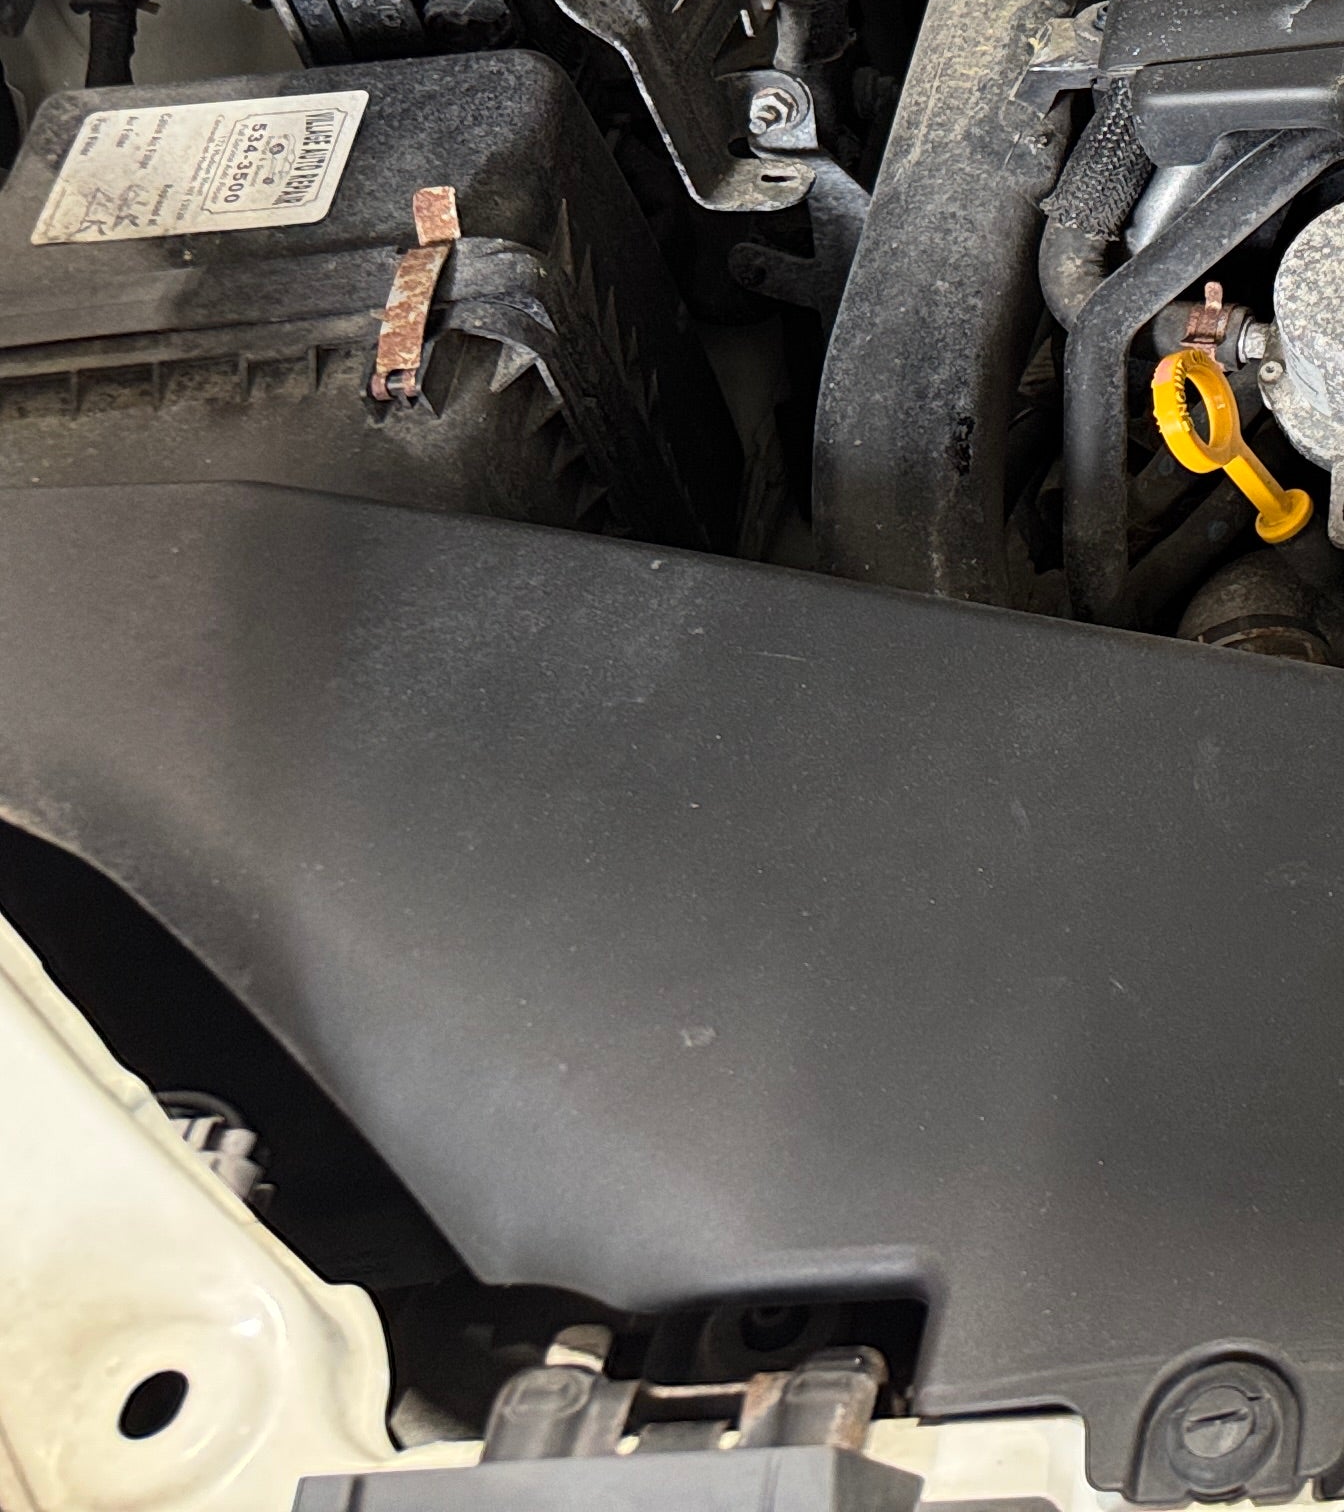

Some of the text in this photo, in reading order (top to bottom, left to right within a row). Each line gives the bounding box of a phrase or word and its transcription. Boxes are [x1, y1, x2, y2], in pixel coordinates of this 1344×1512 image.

[223, 123, 268, 204] 534-3500
[272, 111, 335, 206] VILLAGE AUTO REPAIR
